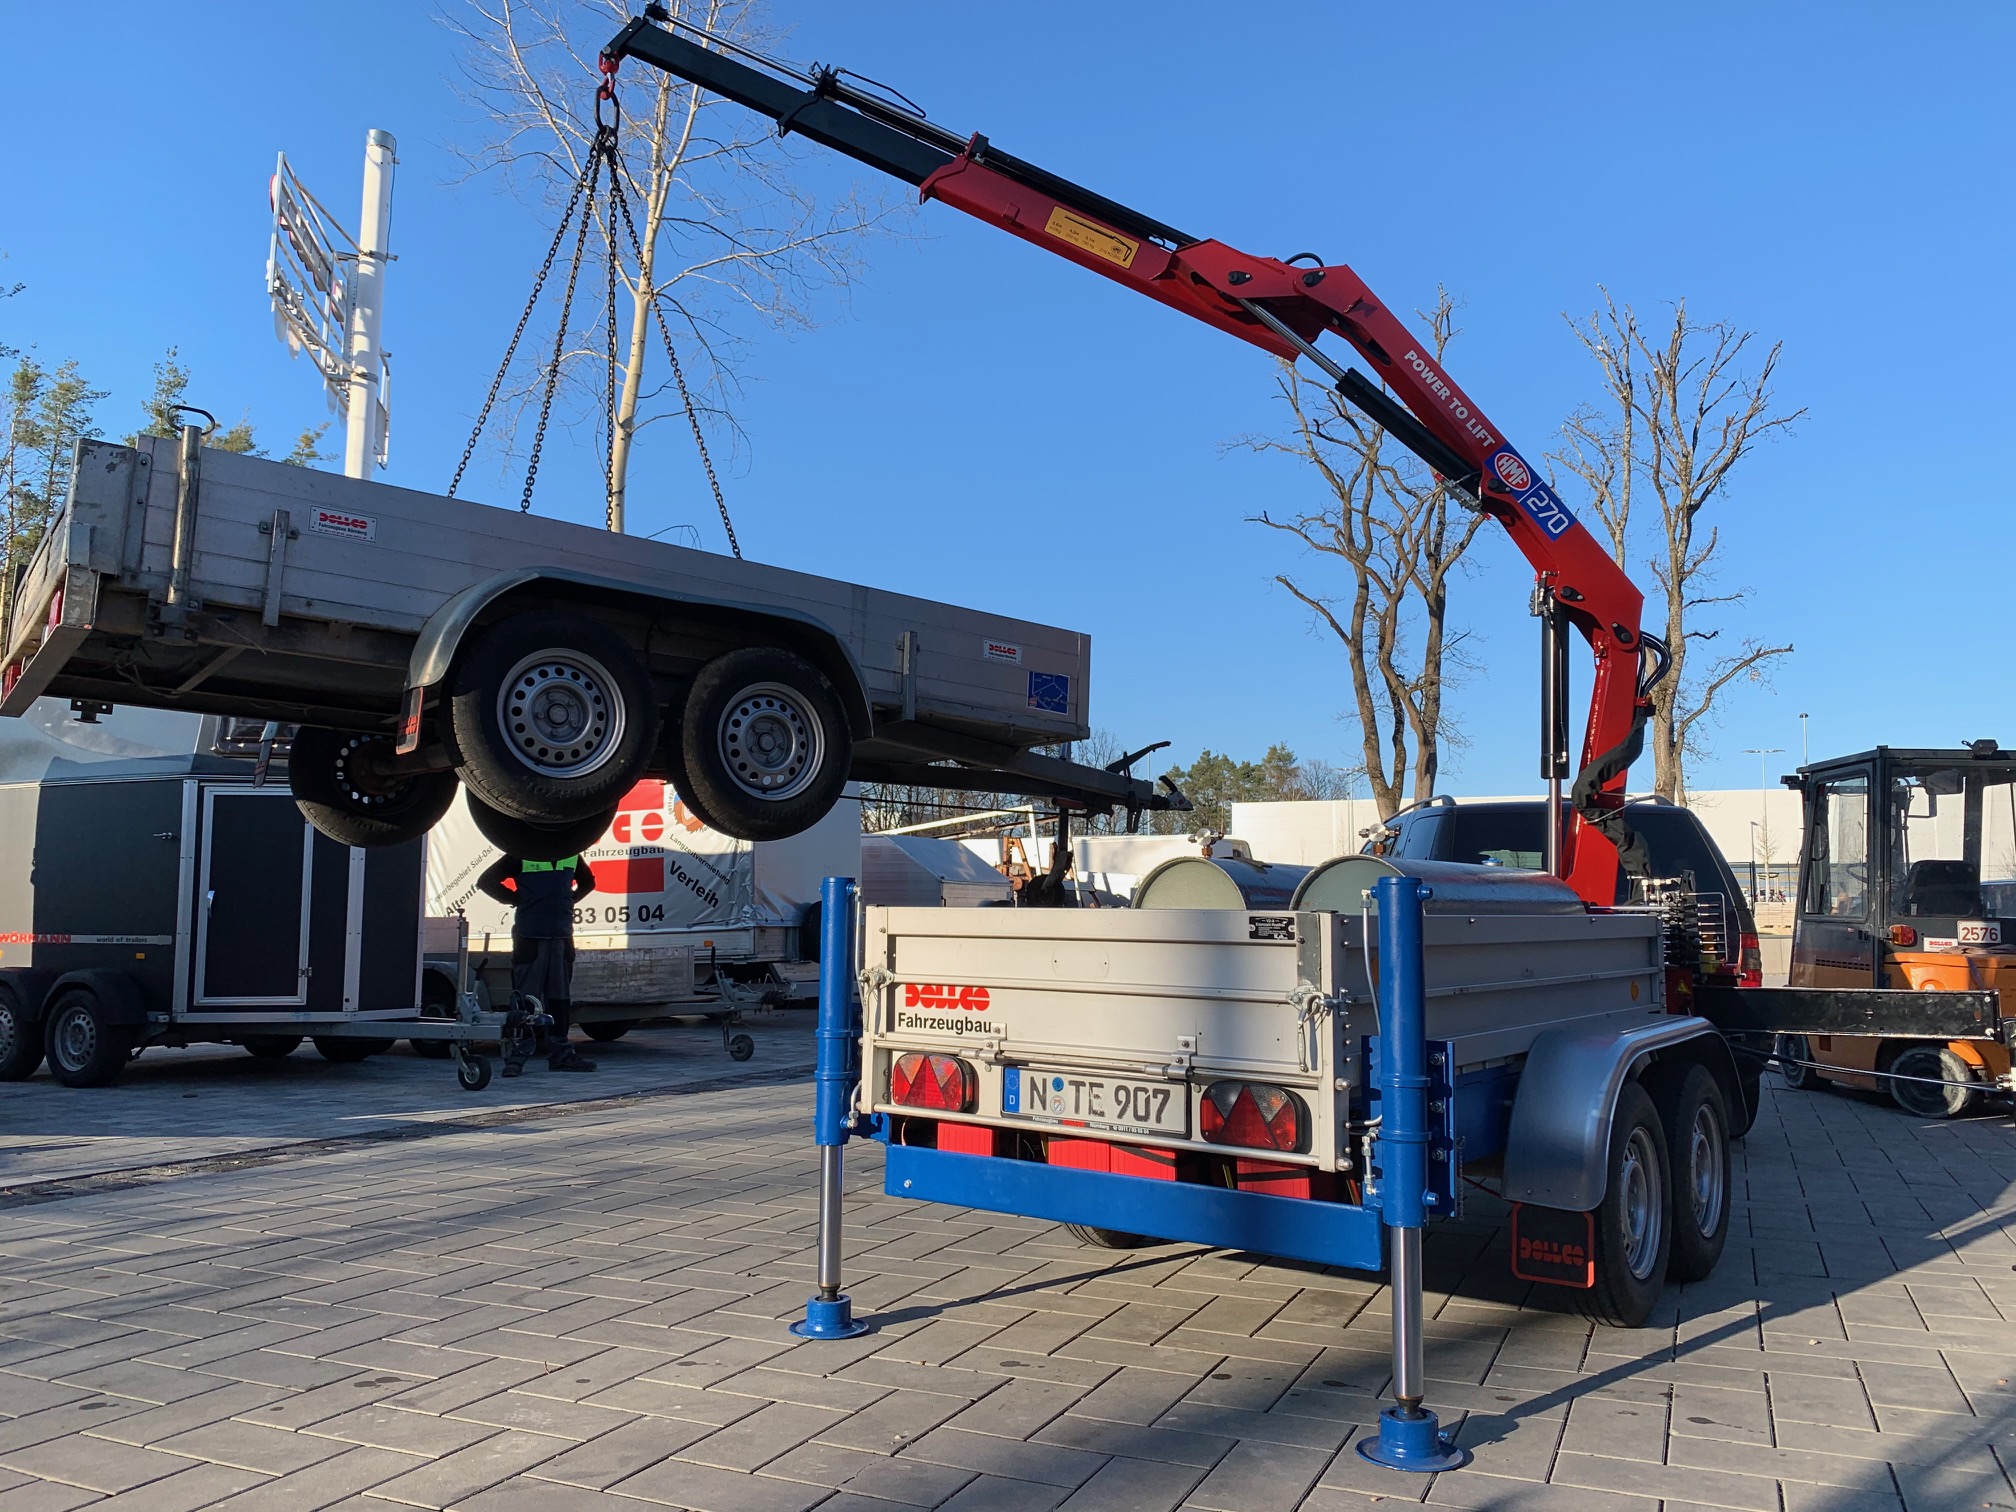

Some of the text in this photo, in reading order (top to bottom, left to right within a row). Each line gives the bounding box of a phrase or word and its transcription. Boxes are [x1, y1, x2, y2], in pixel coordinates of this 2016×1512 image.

[1404, 350, 1495, 447] POWER TO LIFT
[1498, 456, 1527, 485] HMF
[319, 512, 368, 529] DOLLCO
[1526, 490, 1569, 534] 270
[470, 845, 494, 869] Süd-Ost
[583, 846, 665, 858] Fahrzeugbau
[669, 833, 731, 885] Langzeitvermietung
[669, 860, 719, 909] Verleih
[604, 906, 630, 923] 05
[638, 904, 665, 922] 04
[0, 931, 71, 944] WÖRMANN
[1961, 927, 1998, 941] 2576
[905, 982, 990, 1011] DOLLCO
[898, 1012, 992, 1035] Fahrzeugbau
[1009, 1094, 1016, 1105] D
[1029, 1076, 1171, 1124] N TE 907
[1089, 1122, 1110, 1131] Nürnberg
[1520, 1237, 1584, 1266] DOLLCO
